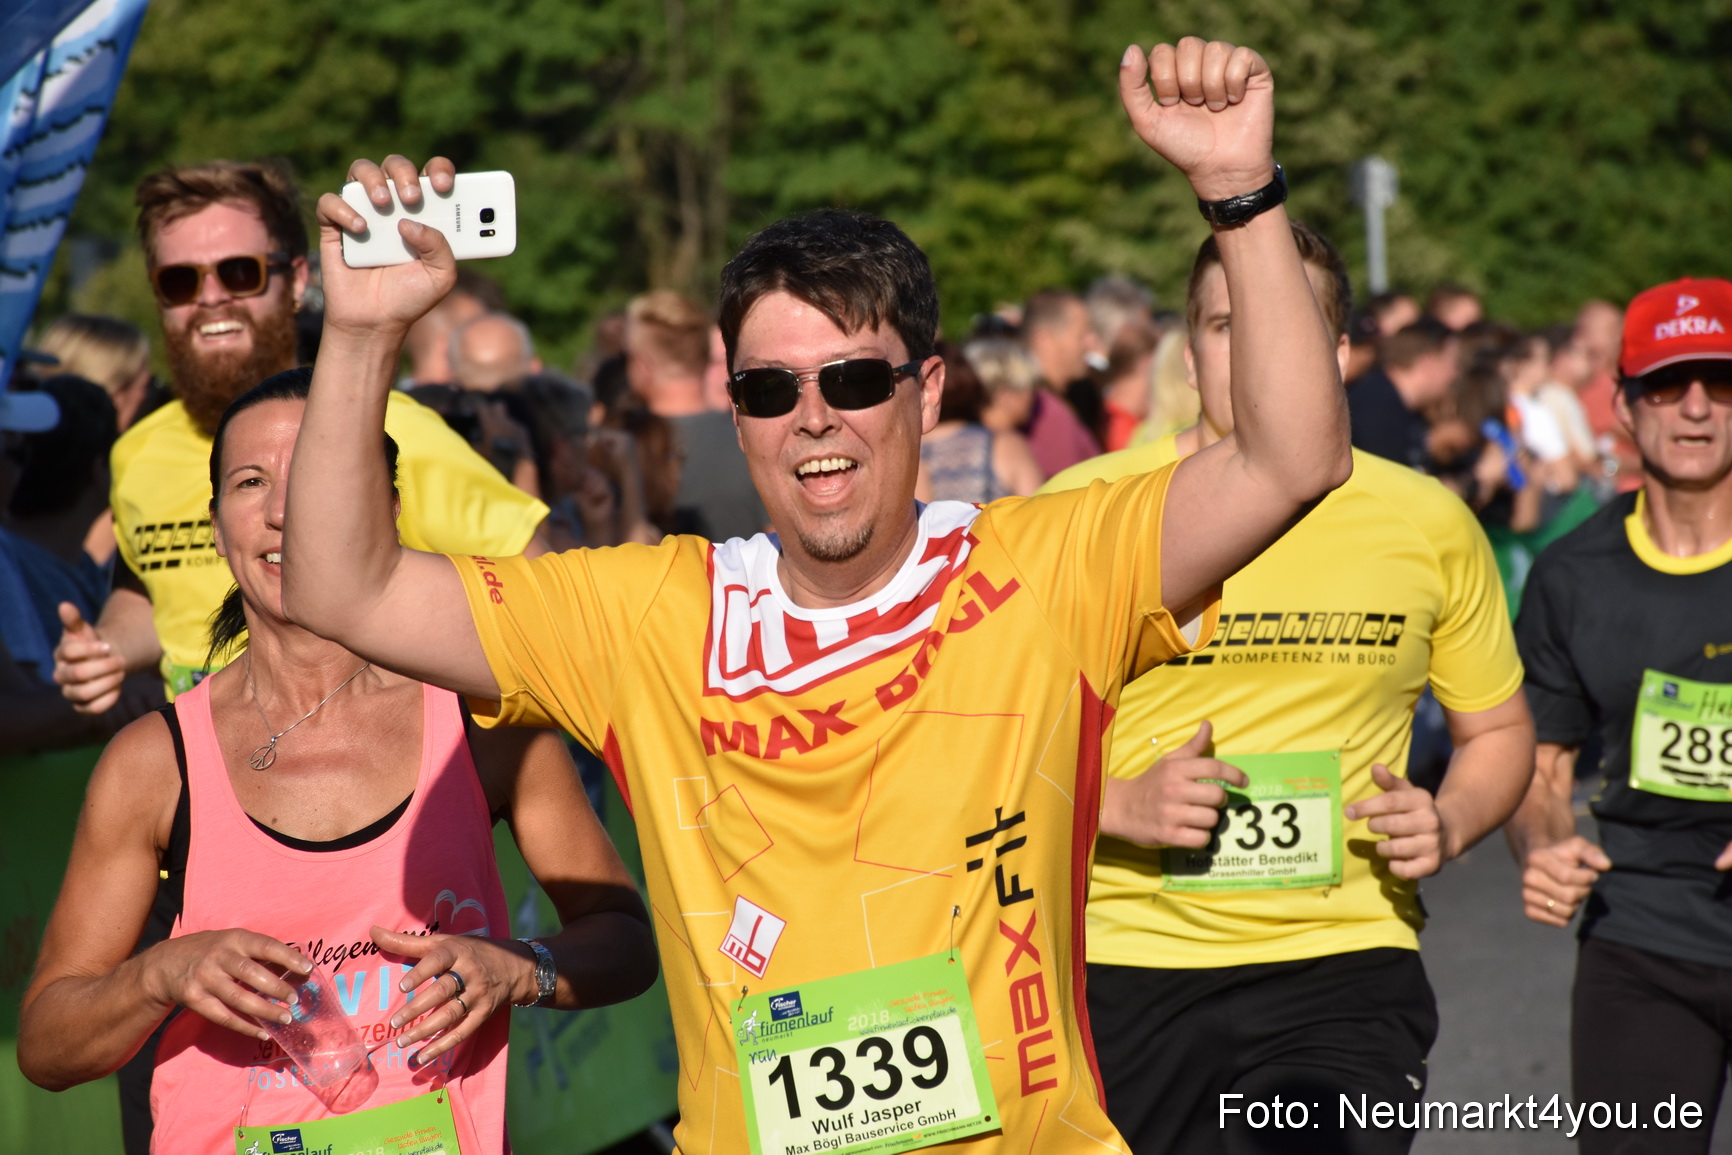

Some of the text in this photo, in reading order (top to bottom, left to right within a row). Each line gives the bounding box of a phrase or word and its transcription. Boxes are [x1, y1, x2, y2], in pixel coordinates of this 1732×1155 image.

[1655, 316, 1725, 341] DEKRA
[1221, 652, 1396, 666] KOMPETENZ IM BÜRO
[700, 699, 859, 760] MAX
[1213, 803, 1301, 850] 33
[1259, 852, 1318, 866] Benedikt
[1268, 867, 1297, 876] GmbH
[760, 1006, 833, 1037] firmenlauf
[848, 1009, 890, 1031] 2018
[768, 1025, 949, 1120] 1339
[785, 1145, 810, 1155] Max
[813, 1135, 841, 1150] Bögl
[845, 1121, 914, 1144] Bauservice
[918, 1108, 957, 1127] GmbH
[812, 1099, 922, 1135] Wulf Jasper
